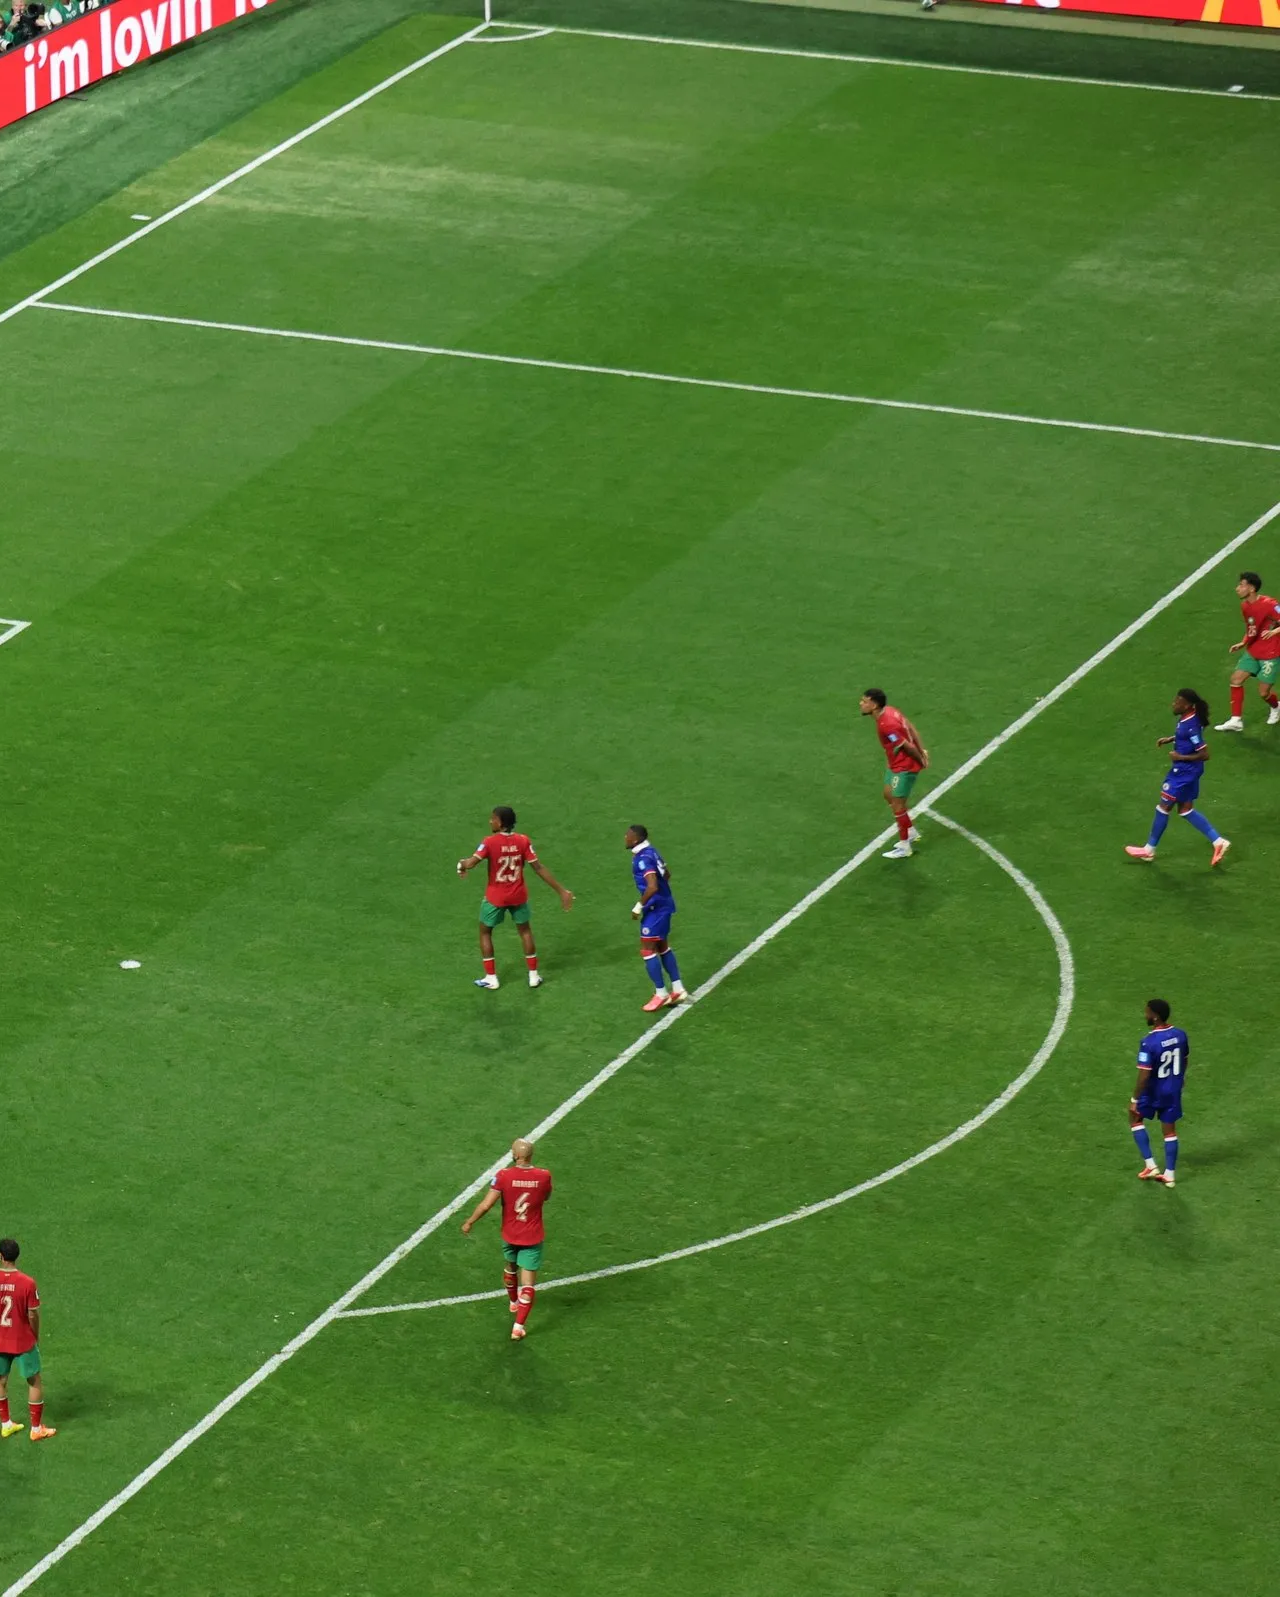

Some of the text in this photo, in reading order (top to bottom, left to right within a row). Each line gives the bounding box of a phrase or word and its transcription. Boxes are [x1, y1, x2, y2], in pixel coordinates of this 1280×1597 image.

[24, 38, 89, 114] i'm
[100, 0, 212, 77] lovin
[495, 854, 522, 883] 25
[1157, 1047, 1180, 1078] 21
[514, 1192, 531, 1222] 4
[0, 1295, 13, 1327] 2
